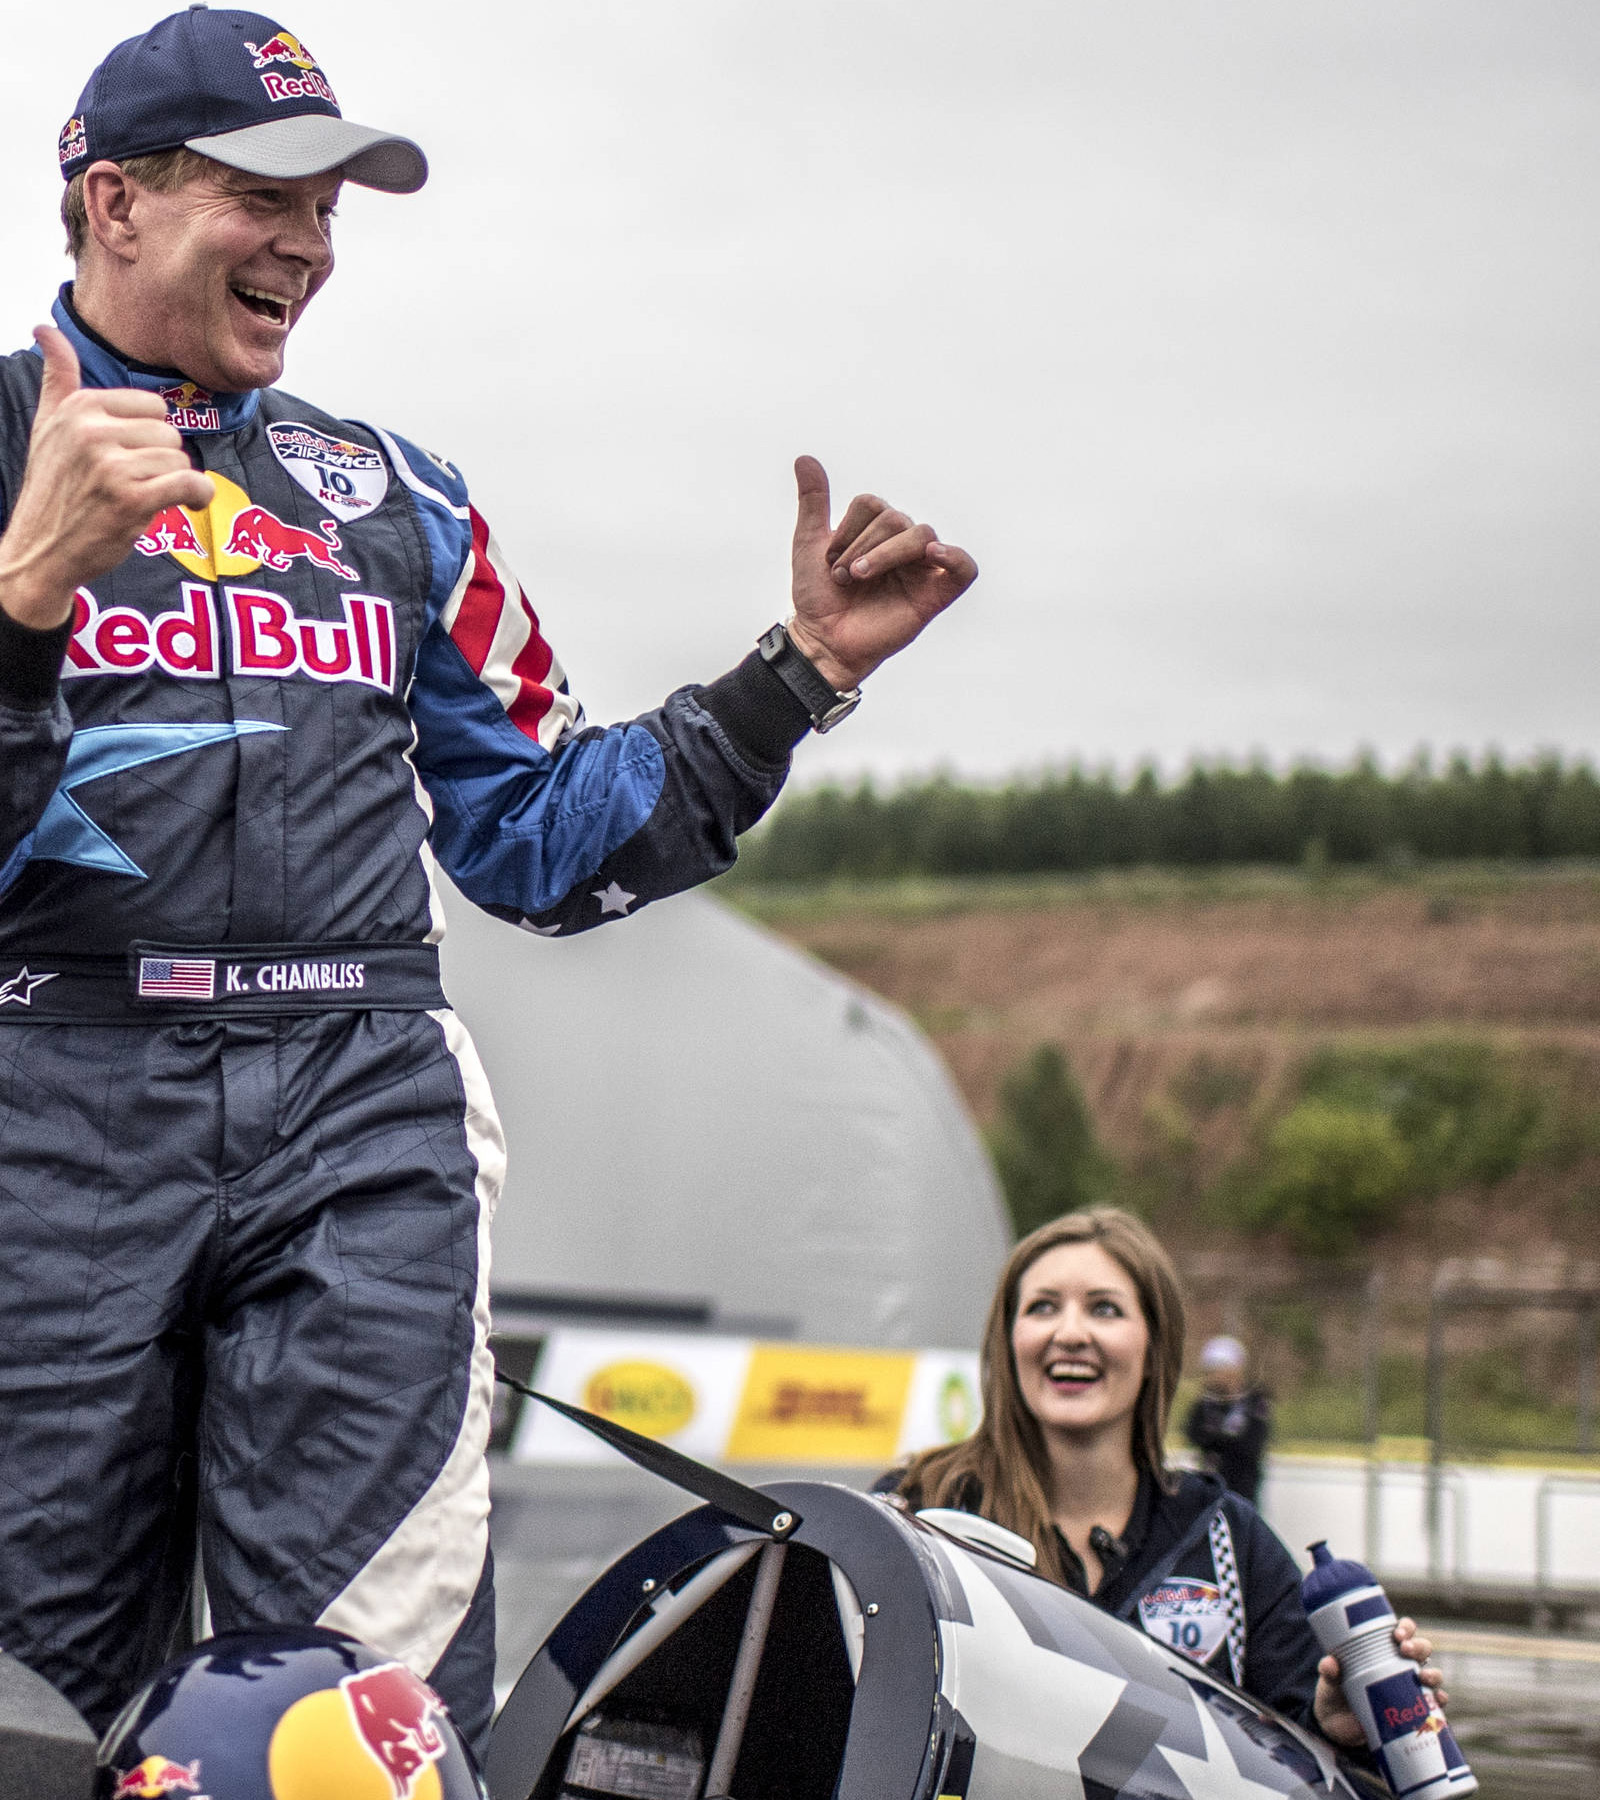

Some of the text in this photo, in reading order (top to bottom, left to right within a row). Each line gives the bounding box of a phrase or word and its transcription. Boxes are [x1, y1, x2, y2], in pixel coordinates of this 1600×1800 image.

[260, 70, 320, 102] Red
[165, 407, 220, 430] ed Bull
[272, 430, 331, 453] Red Bull
[323, 451, 382, 469] RACE
[314, 464, 357, 497] 10
[224, 586, 397, 696] Bull
[226, 963, 365, 992] K. CHAMBLISS
[1168, 1621, 1202, 1650] 10
[1383, 1694, 1428, 1728] Red
